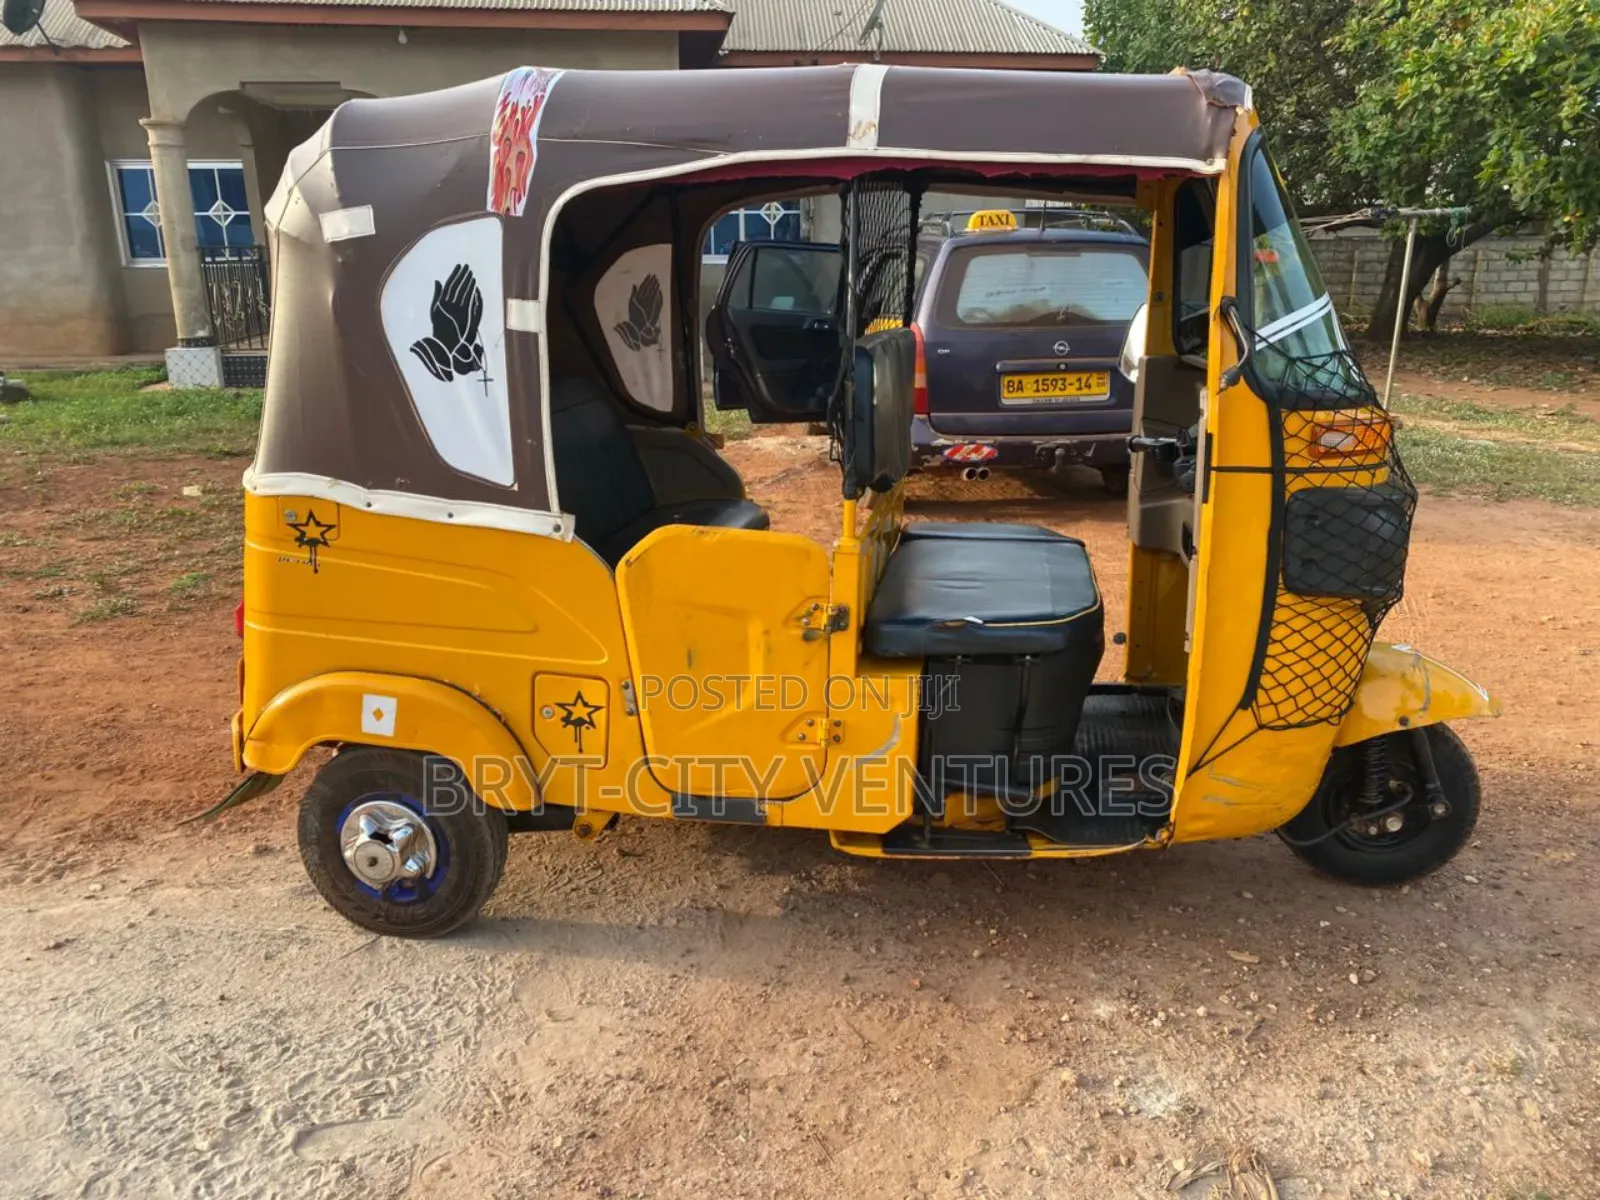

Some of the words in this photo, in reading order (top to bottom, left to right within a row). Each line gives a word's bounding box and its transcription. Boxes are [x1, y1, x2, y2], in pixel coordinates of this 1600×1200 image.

[977, 213, 1010, 227] TAXI
[1006, 379, 1025, 394] BA
[1033, 374, 1093, 393] 1593-14
